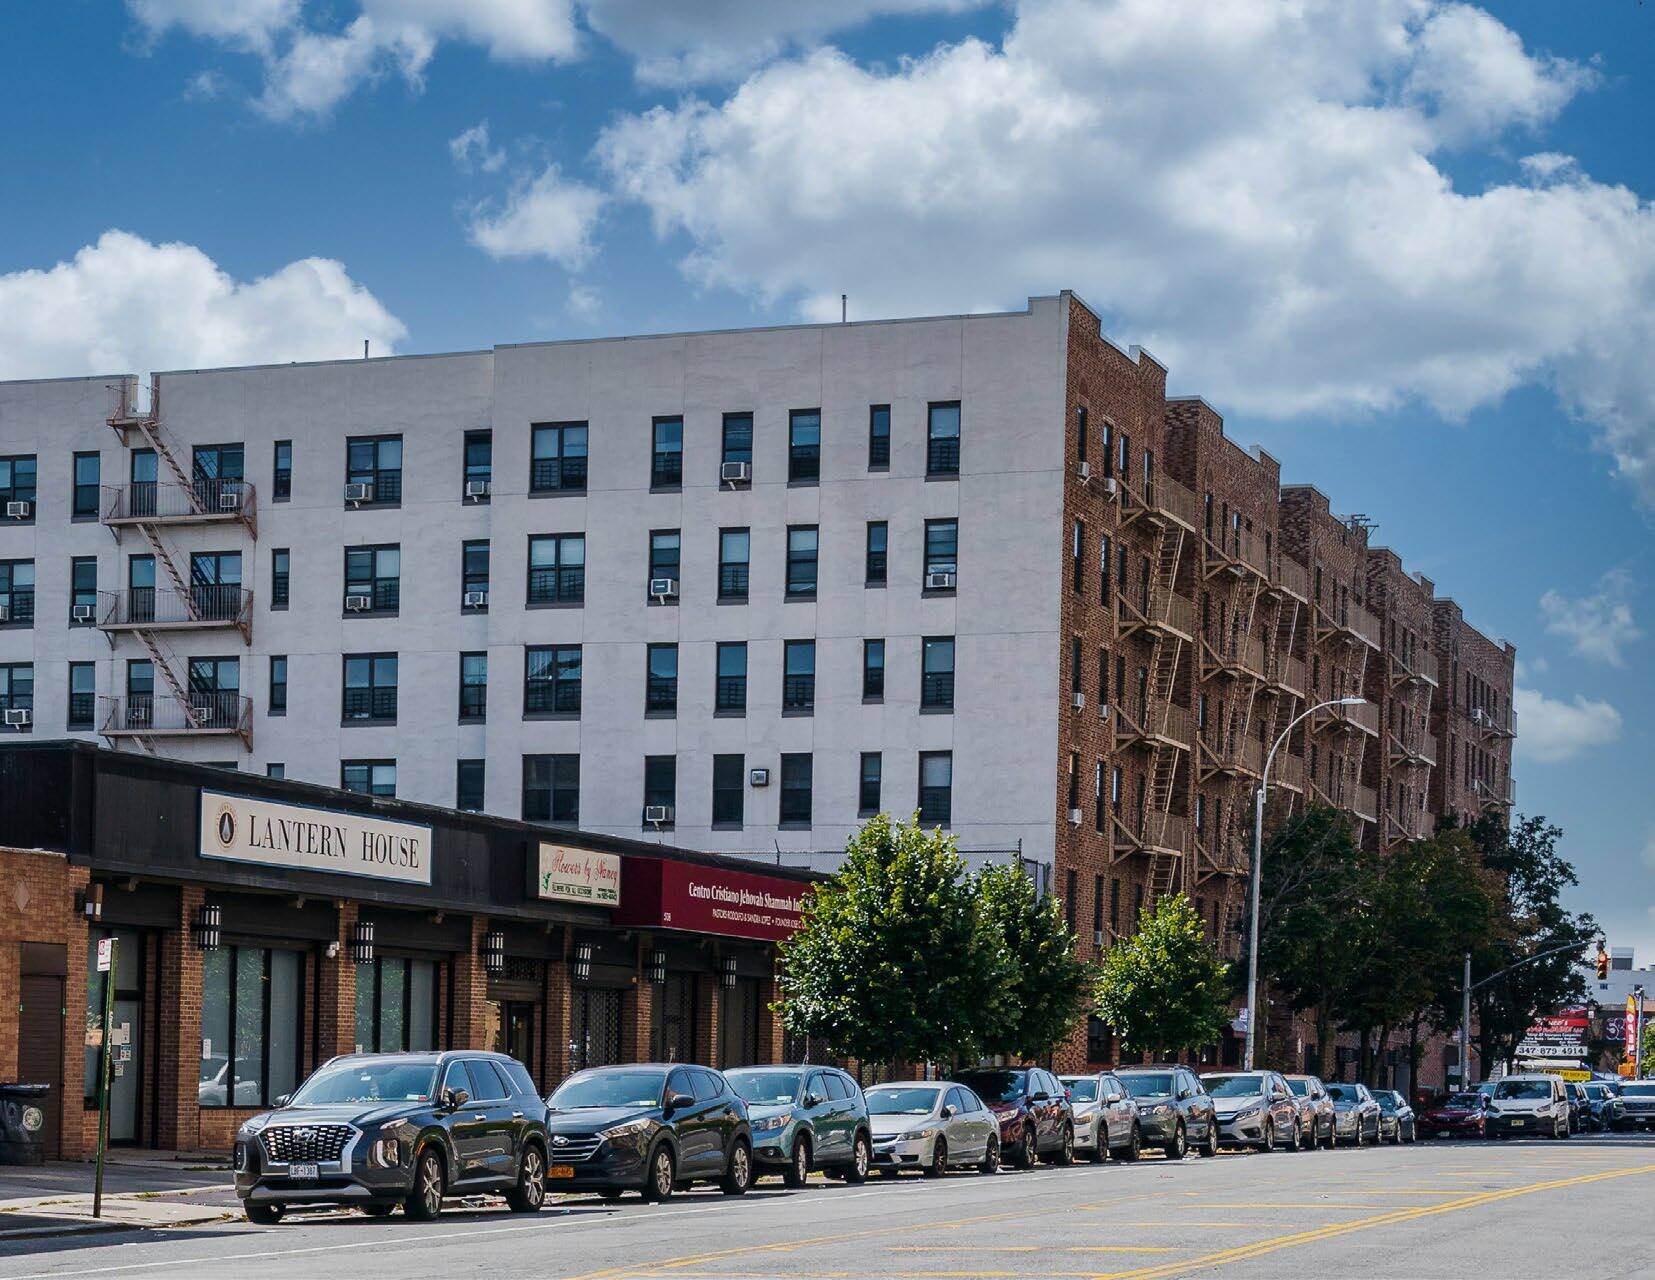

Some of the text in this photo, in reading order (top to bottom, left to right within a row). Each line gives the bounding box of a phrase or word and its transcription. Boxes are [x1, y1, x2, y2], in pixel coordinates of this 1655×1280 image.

[249, 814, 347, 858] LANTERN
[361, 831, 419, 868] HOUSE
[689, 882, 710, 900] Centro
[711, 885, 739, 904] Cristiano
[739, 889, 763, 908] Jehovah
